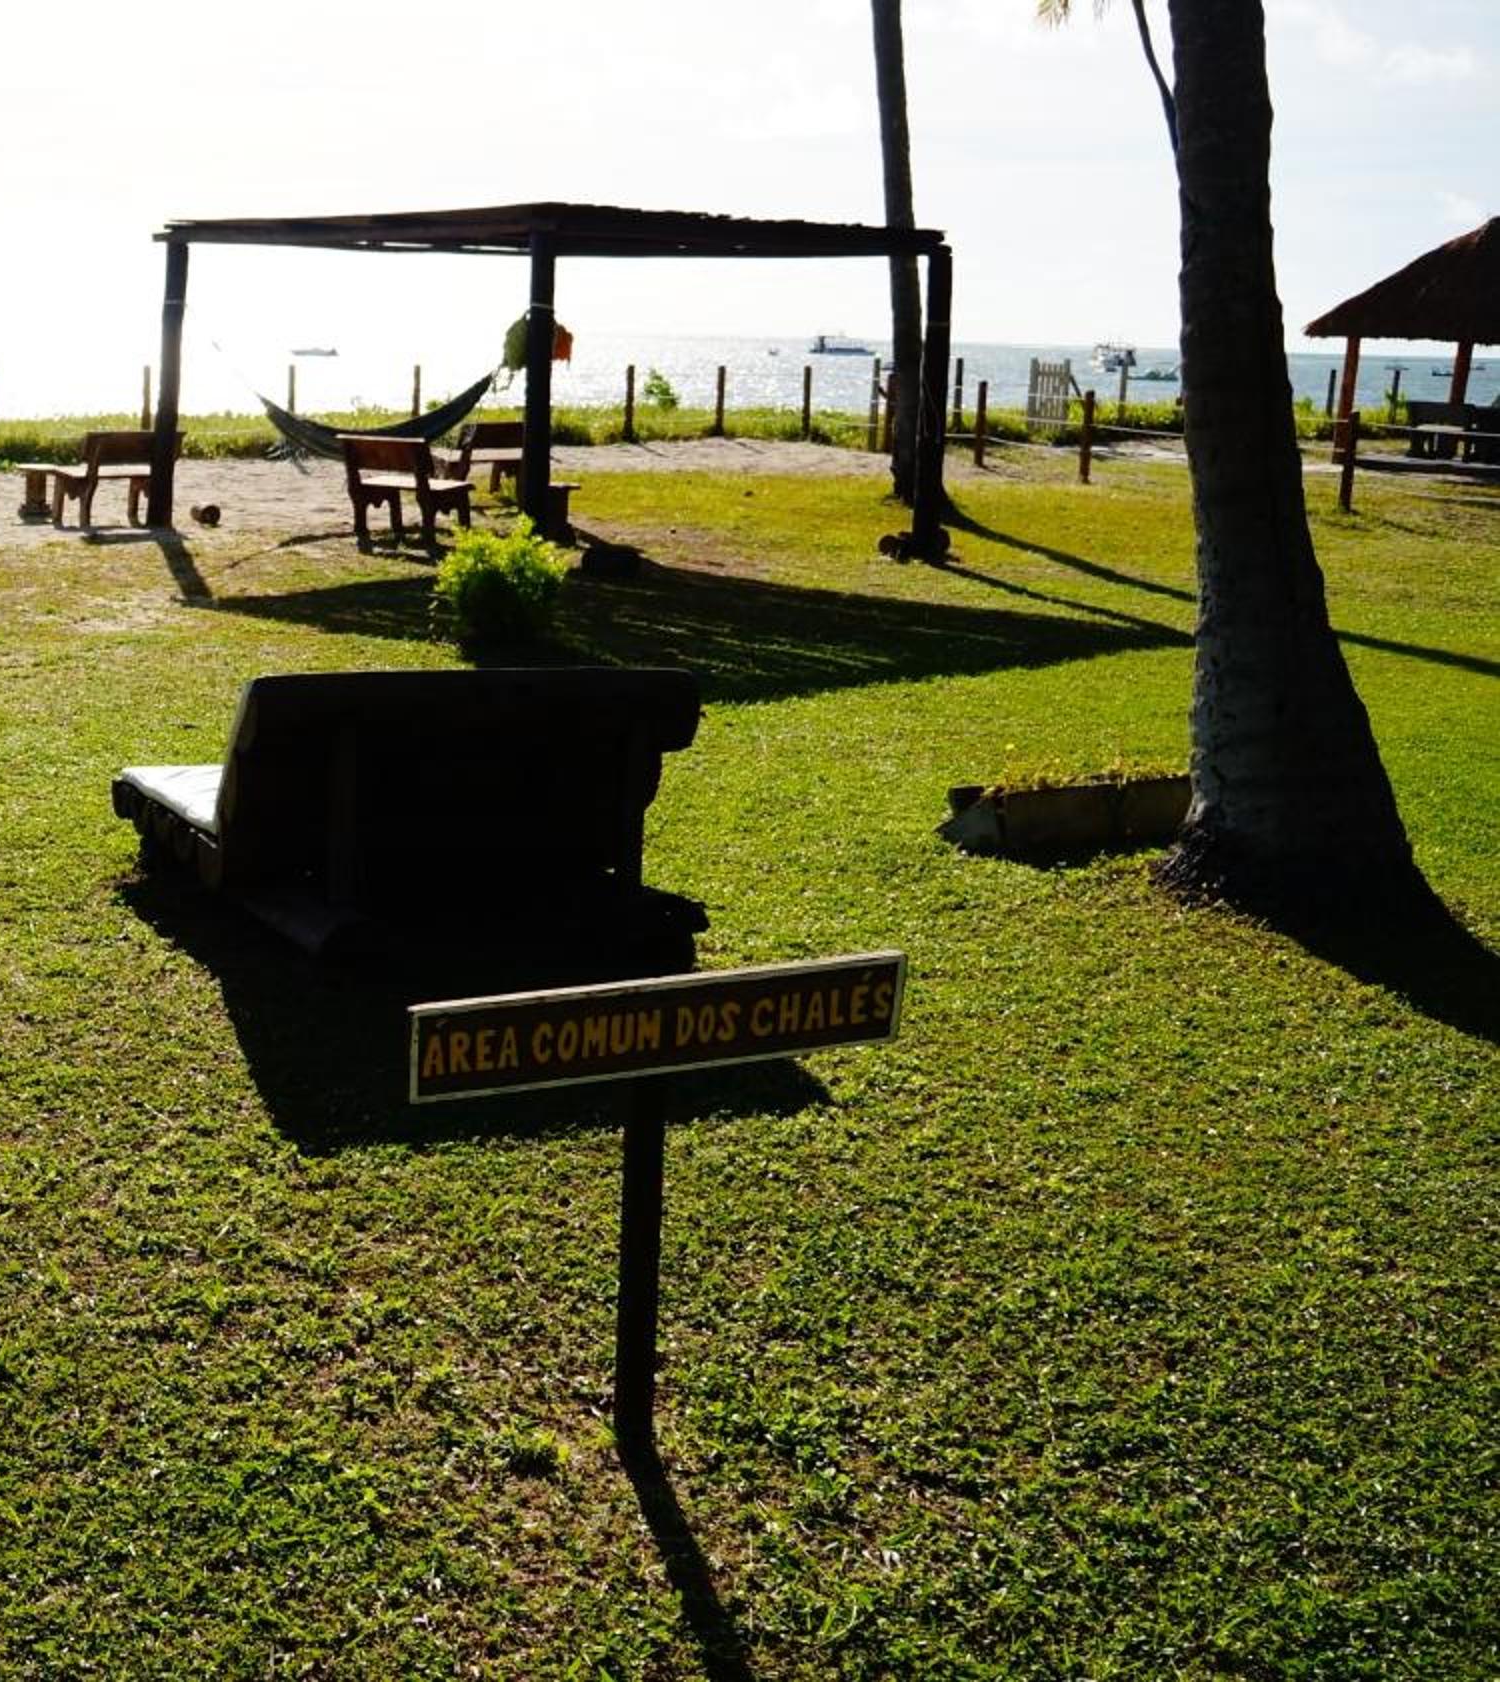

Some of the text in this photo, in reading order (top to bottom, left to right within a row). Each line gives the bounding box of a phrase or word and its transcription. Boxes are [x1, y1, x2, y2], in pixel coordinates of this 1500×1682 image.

[422, 973, 894, 1078] ÁREA COMUM DOS CHALÉS
